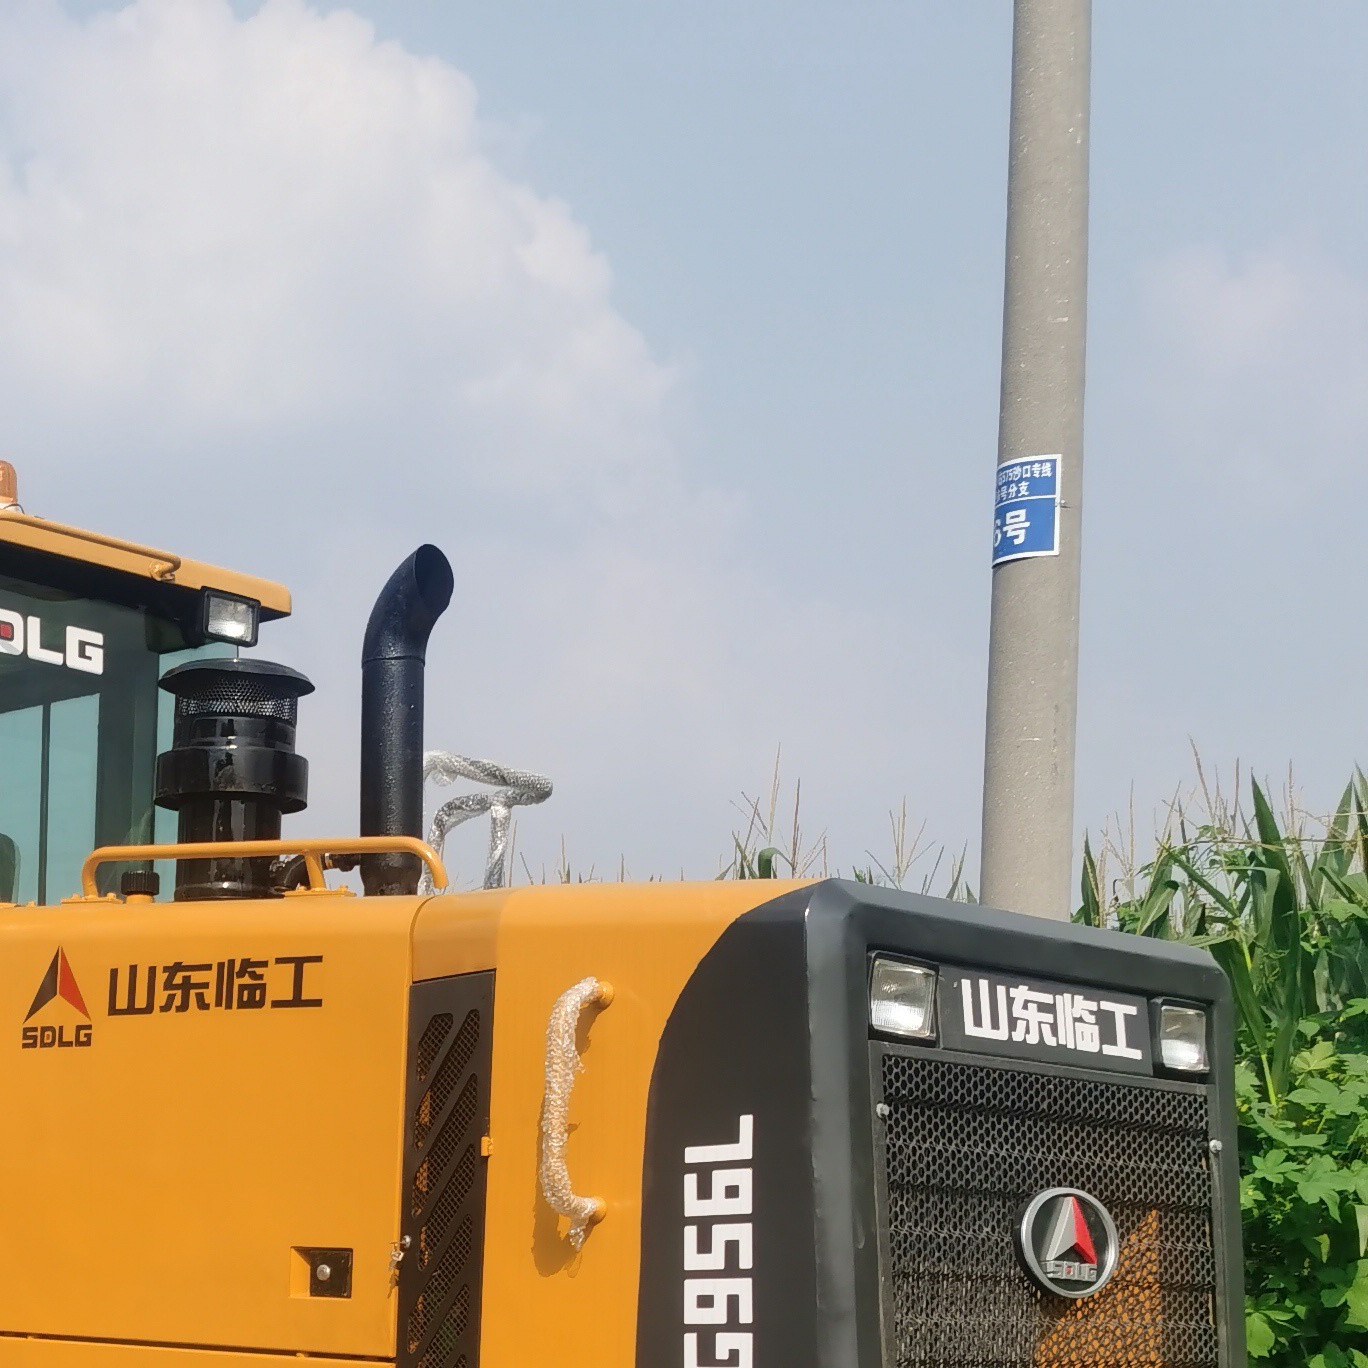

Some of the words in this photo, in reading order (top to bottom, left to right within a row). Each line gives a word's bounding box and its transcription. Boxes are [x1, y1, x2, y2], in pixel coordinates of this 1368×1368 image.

[107, 955, 324, 1016] 山东临工
[21, 1024, 93, 1049] SDLG
[960, 978, 1143, 1060] 山东临工
[1045, 1260, 1098, 1282] SDLG
